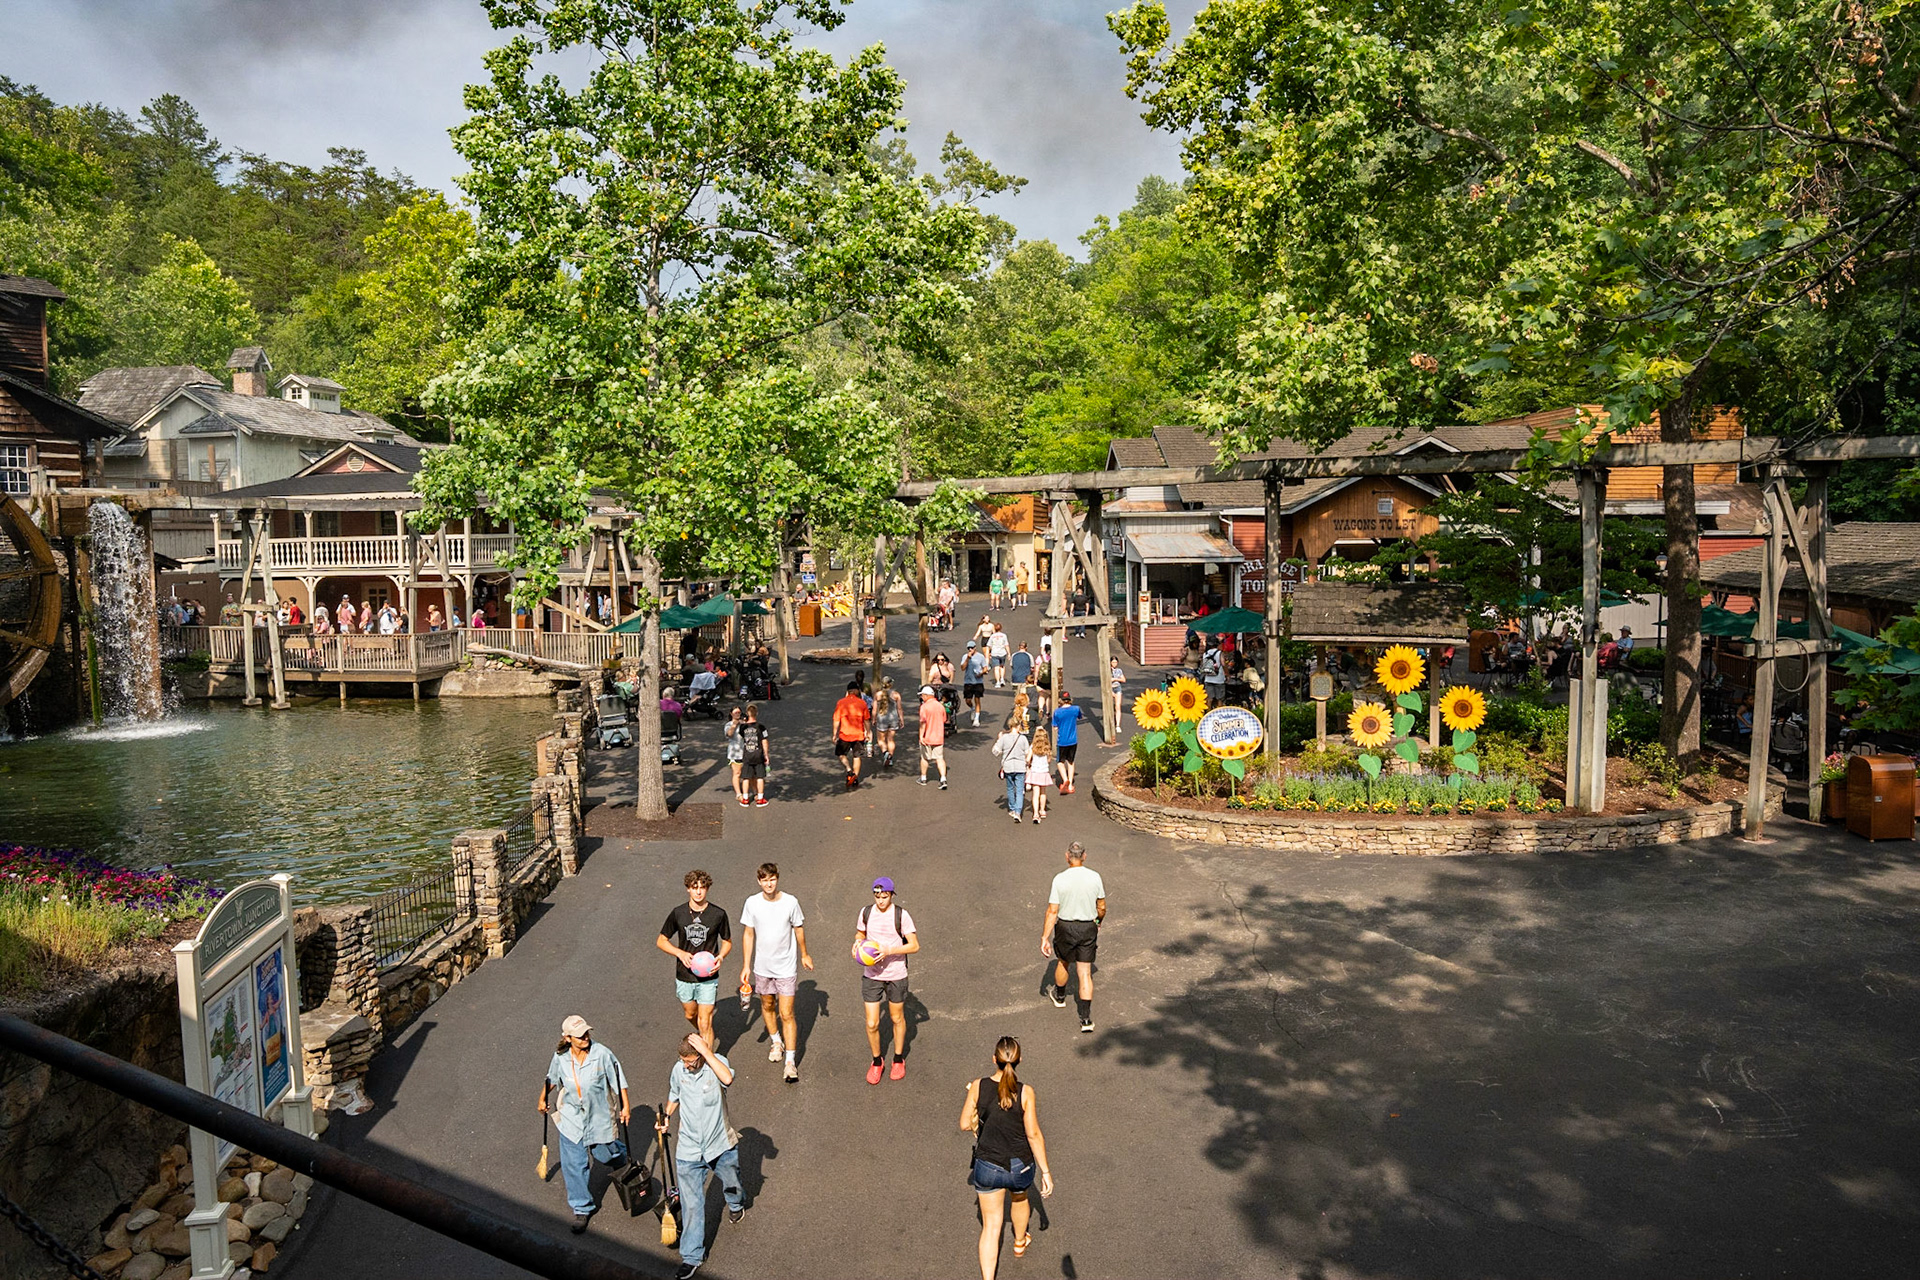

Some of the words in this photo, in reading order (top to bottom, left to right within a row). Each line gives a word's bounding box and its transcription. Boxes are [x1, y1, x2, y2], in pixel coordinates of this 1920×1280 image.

[1333, 519, 1377, 531] WAGONS
[1378, 519, 1393, 530] TO
[1395, 518, 1417, 530] LET
[1212, 718, 1246, 735] SUMMER
[1210, 729, 1250, 743] CELEBRATION
[204, 917, 242, 957] RIVERTOWN
[244, 894, 276, 927] JUNCTION
